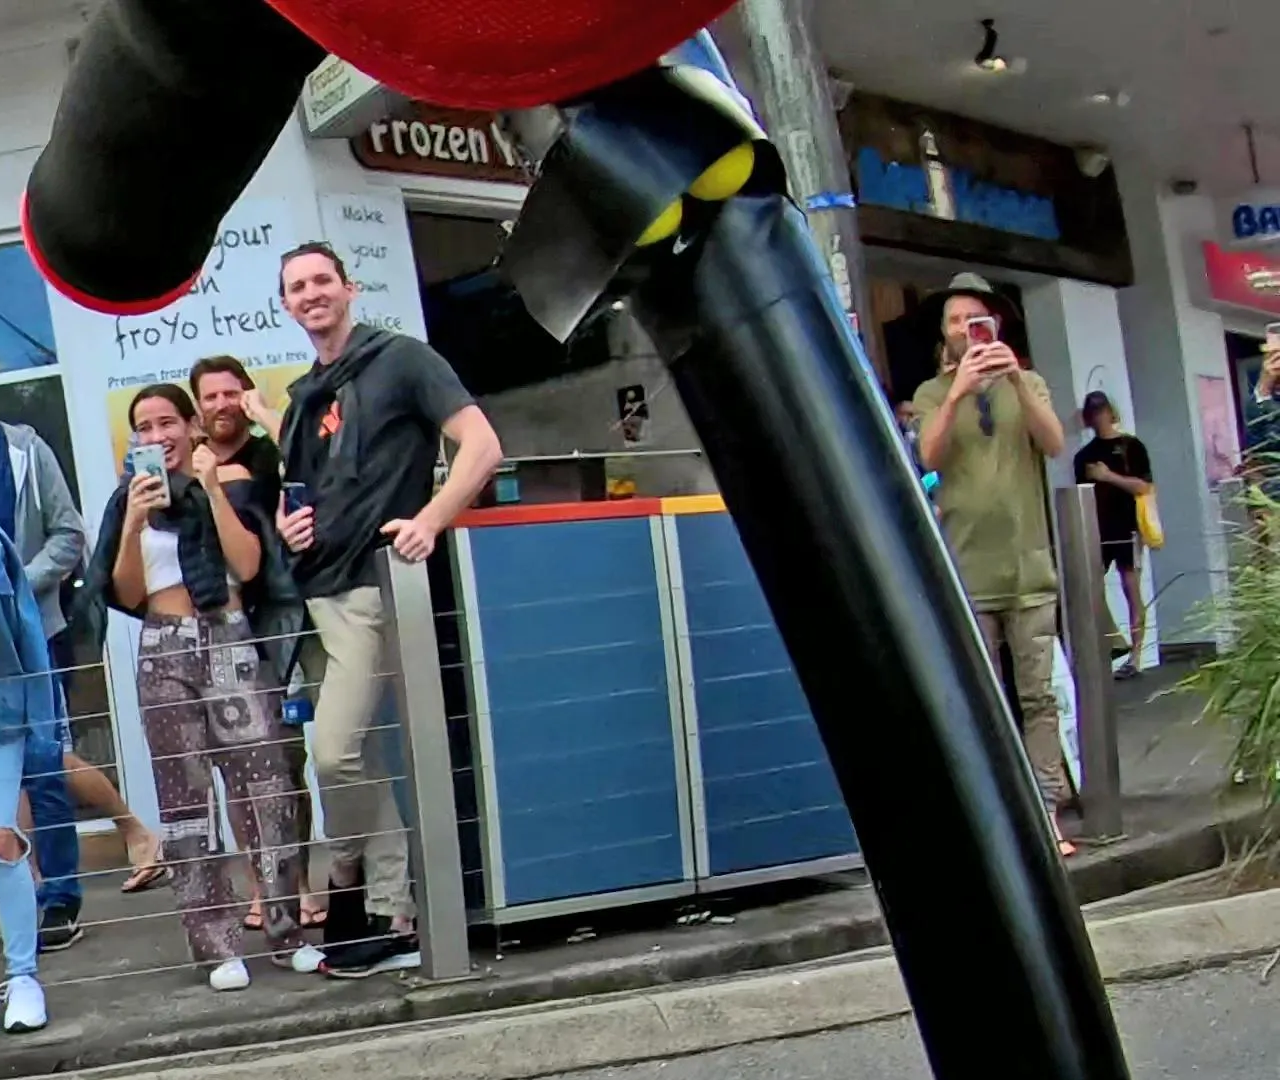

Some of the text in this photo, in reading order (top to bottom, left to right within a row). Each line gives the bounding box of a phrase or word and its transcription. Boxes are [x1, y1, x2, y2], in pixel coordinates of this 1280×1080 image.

[342, 204, 385, 224] Make
[1232, 204, 1280, 240] BA
[211, 297, 282, 337] treat
[160, 367, 190, 381] froze
